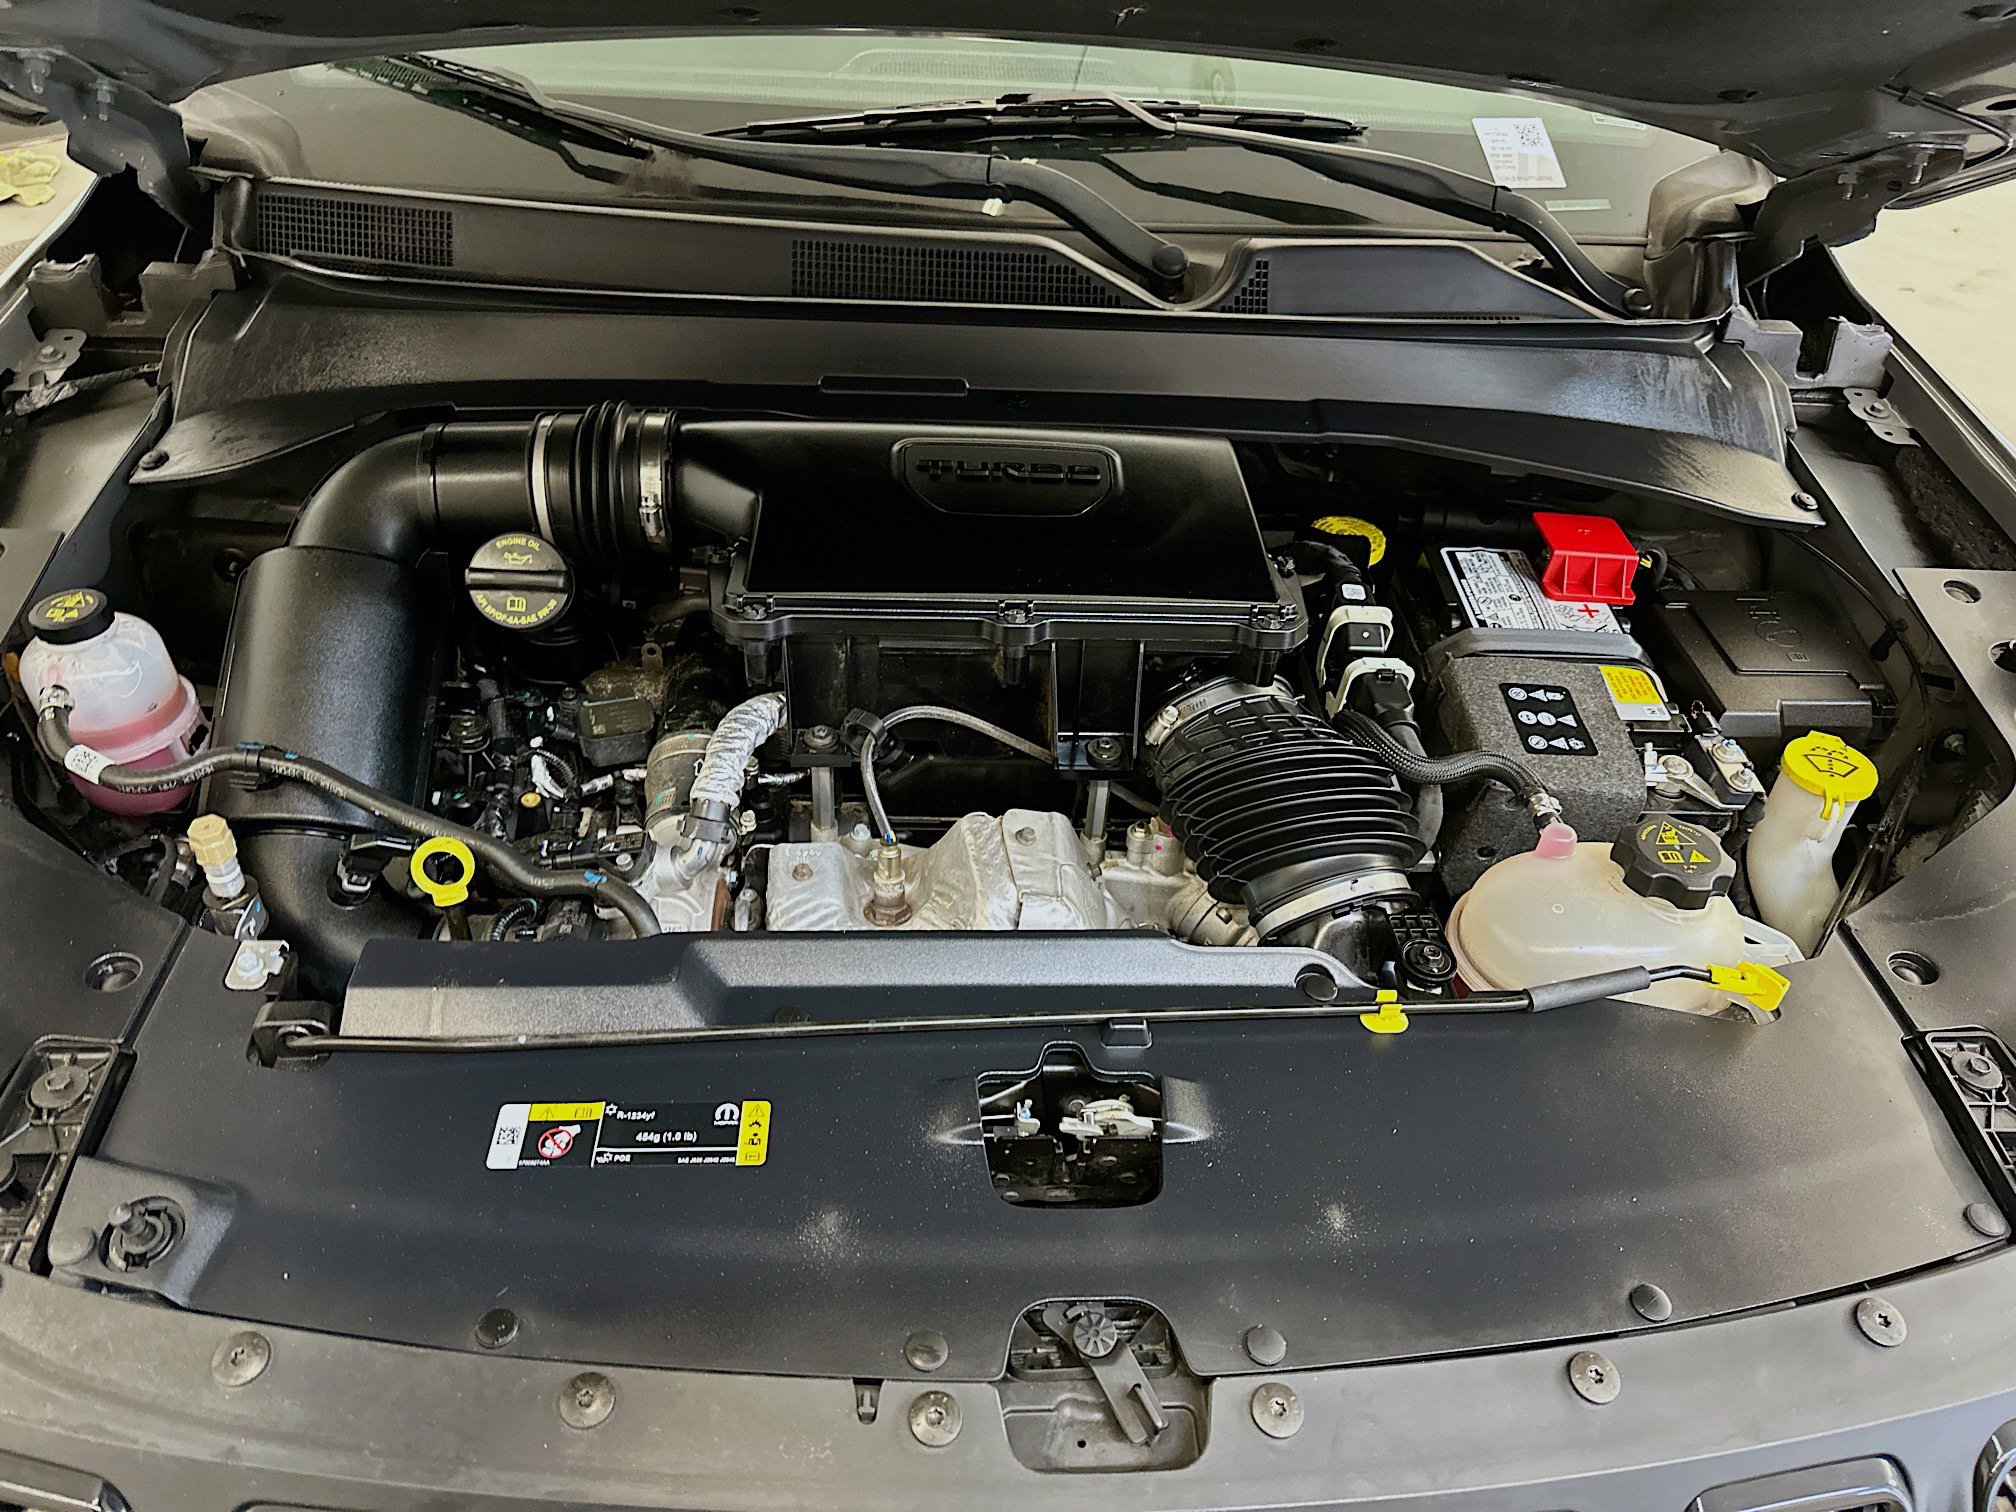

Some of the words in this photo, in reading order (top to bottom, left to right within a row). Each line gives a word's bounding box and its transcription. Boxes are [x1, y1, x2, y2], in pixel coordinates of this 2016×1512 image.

[916, 459, 1101, 484] TURBO
[495, 537, 527, 549] ENGINE
[528, 540, 540, 551] OIL
[662, 1130, 682, 1144] (1.0
[683, 1130, 698, 1143] lb)
